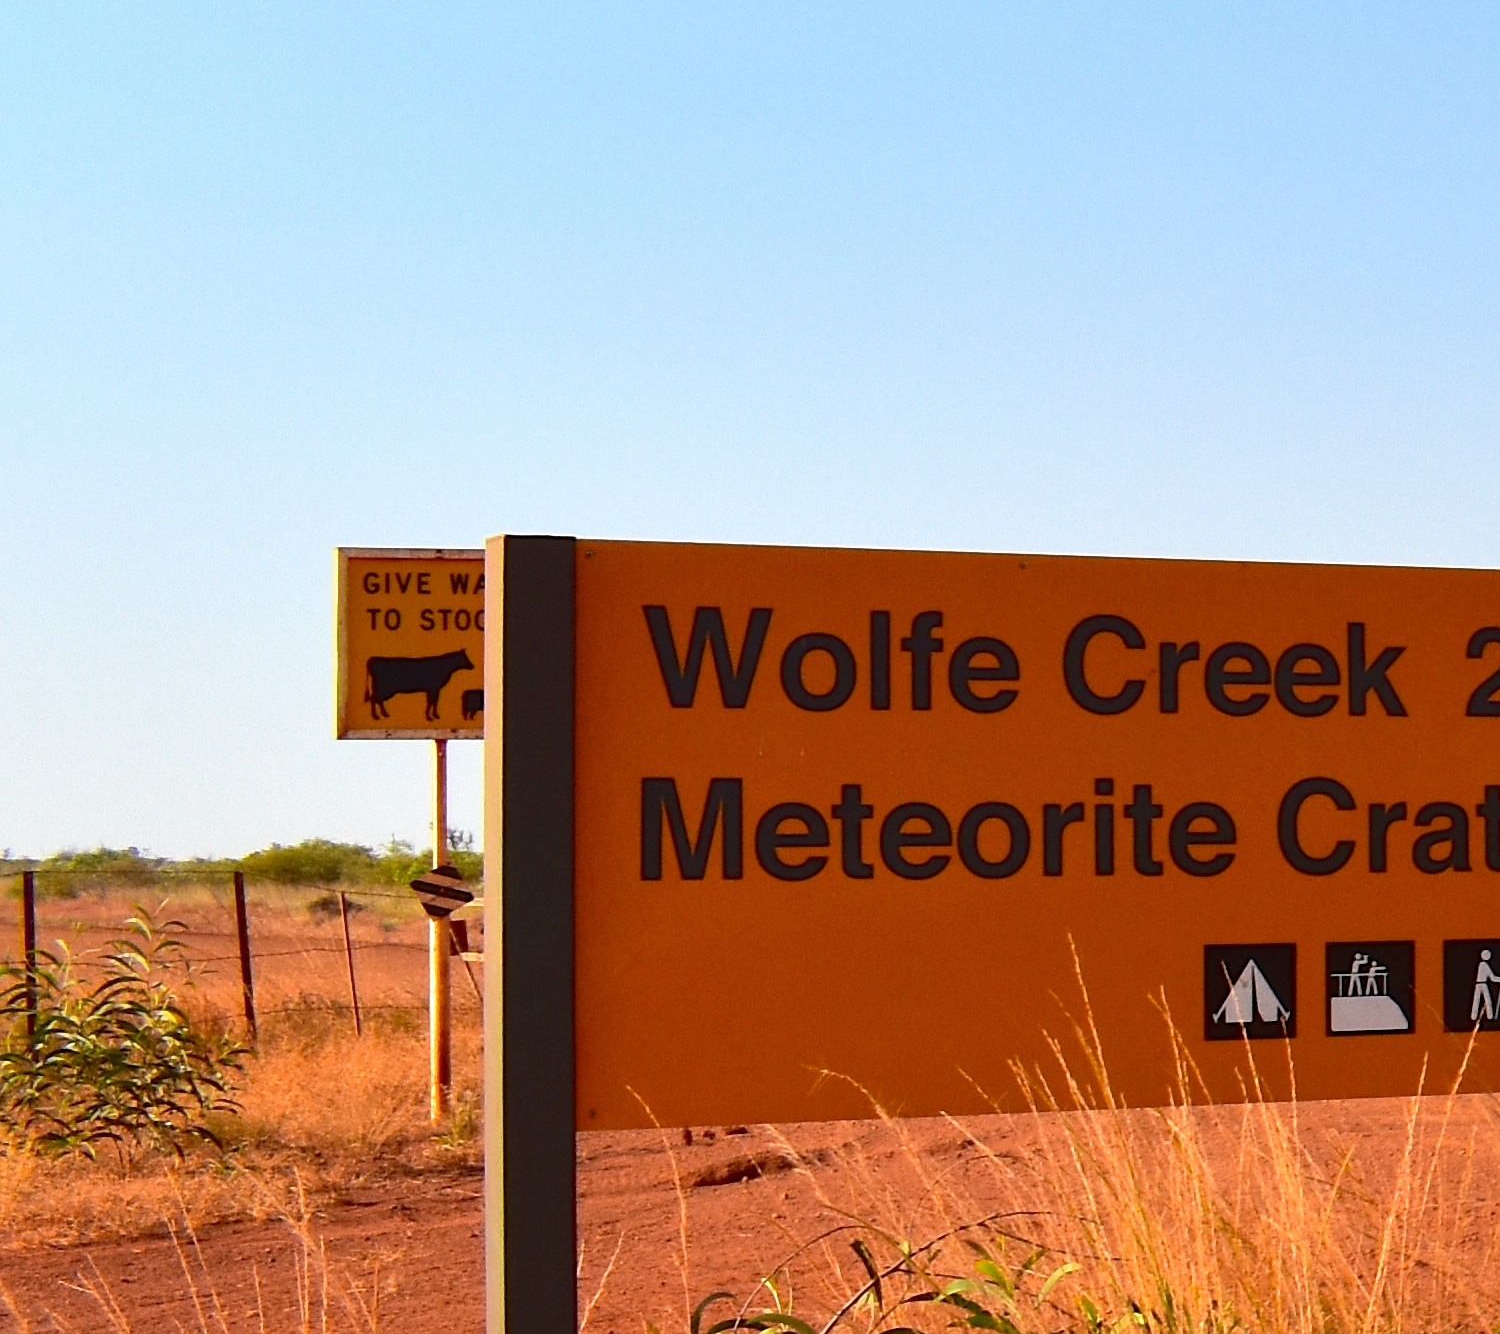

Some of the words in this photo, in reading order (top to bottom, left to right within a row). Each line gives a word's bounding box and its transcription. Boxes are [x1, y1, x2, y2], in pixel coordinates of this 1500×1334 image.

[363, 572, 431, 595] GIVE
[449, 573, 485, 595] WA
[366, 608, 401, 631] TO
[420, 608, 485, 631] STOC
[642, 604, 1021, 715] Wolfe
[1062, 613, 1409, 718] Creek
[640, 776, 1238, 882] Meteorite
